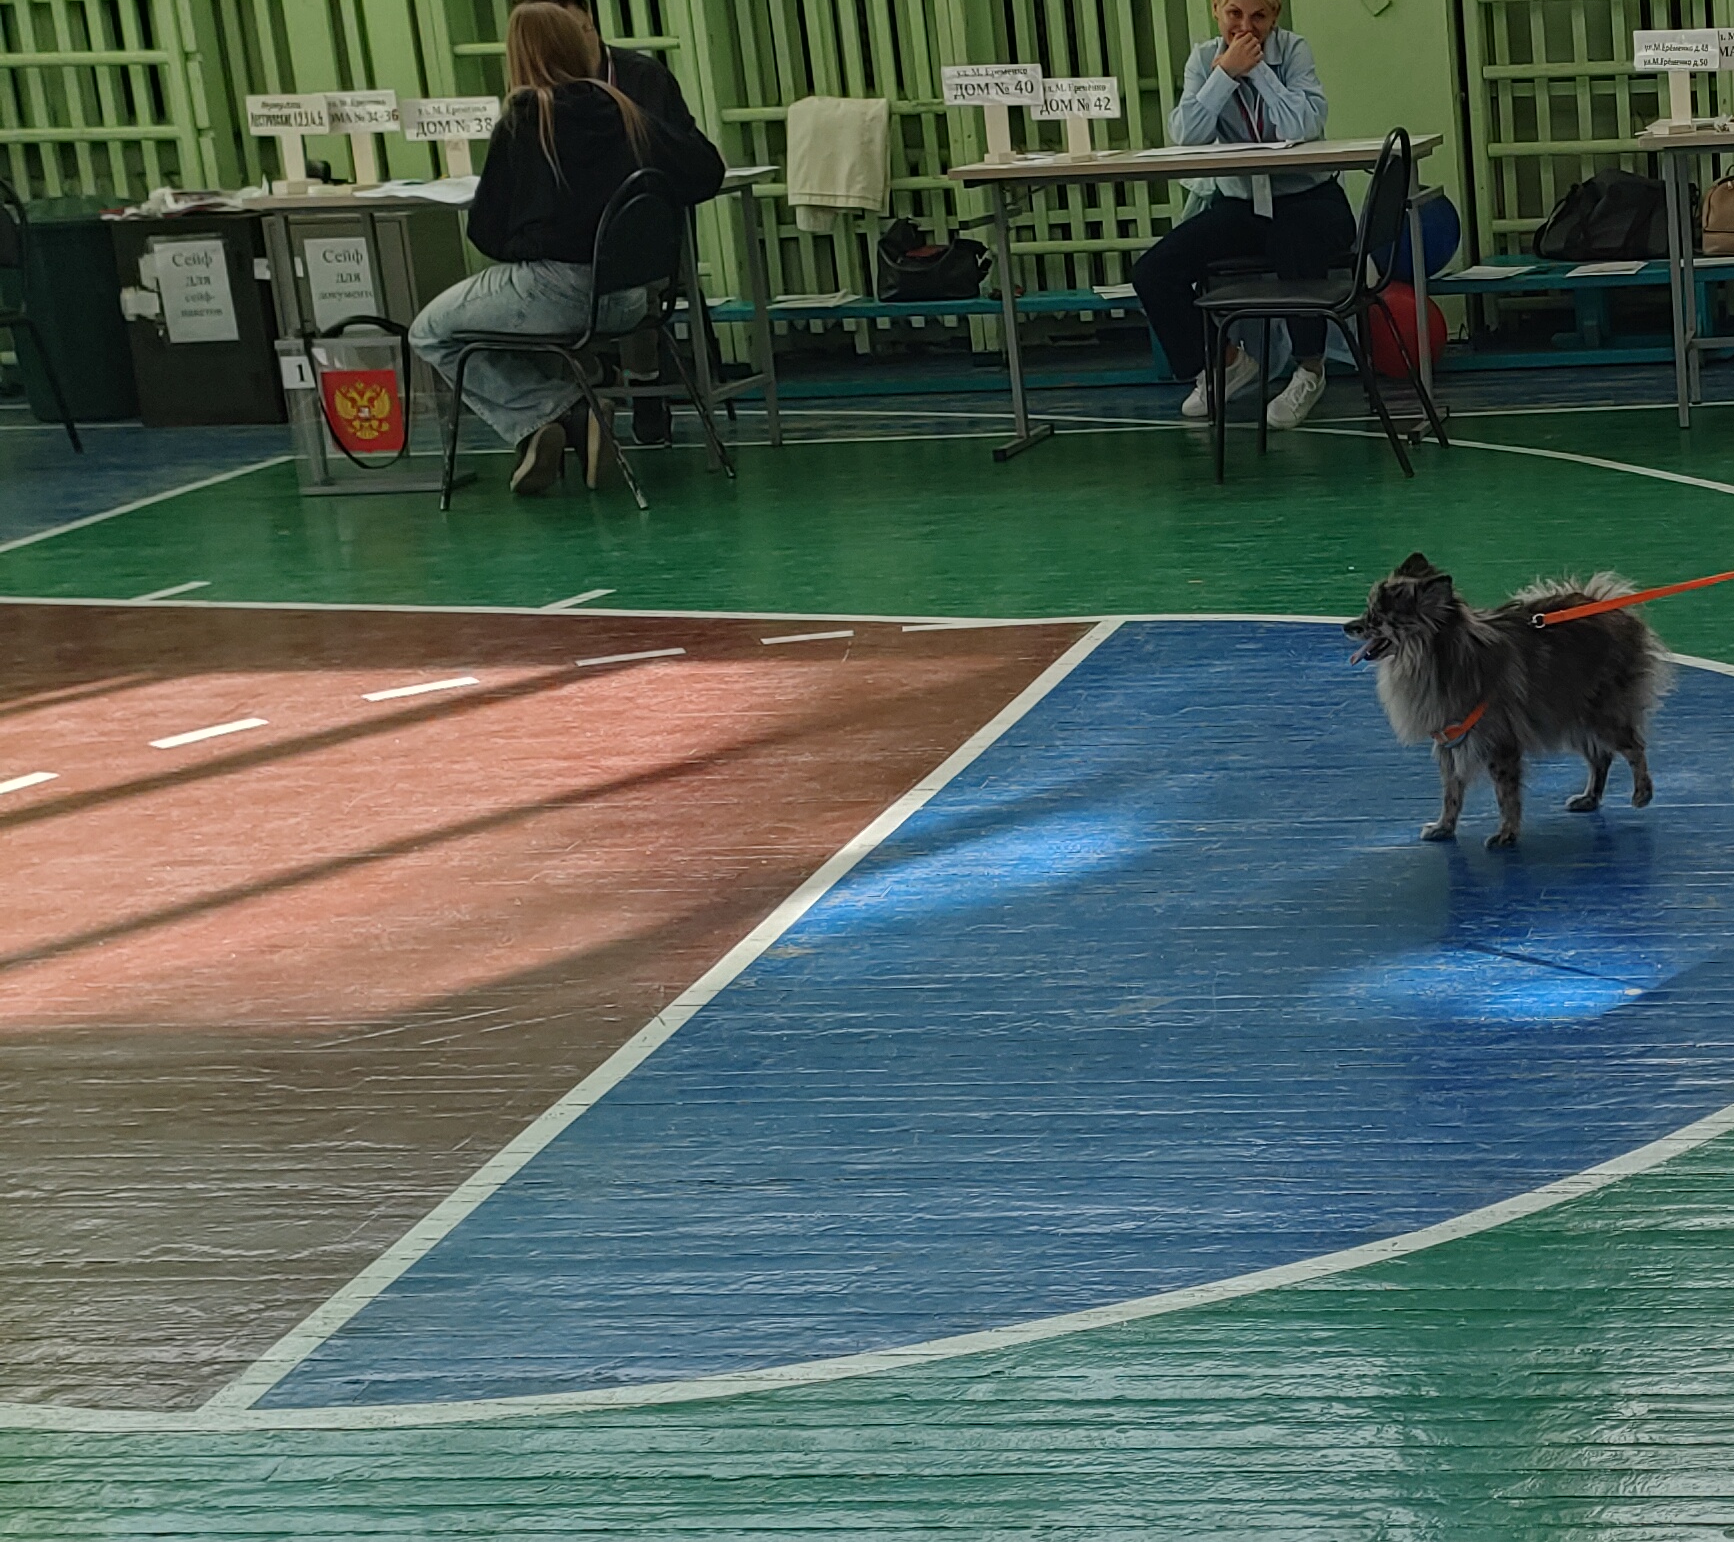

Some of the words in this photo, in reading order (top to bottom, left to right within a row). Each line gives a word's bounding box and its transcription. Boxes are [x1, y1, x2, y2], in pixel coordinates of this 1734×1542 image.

[954, 83, 990, 100] ДОМ
[1014, 80, 1034, 94] 40
[1040, 99, 1073, 116] ДОМ
[1093, 96, 1112, 111] 42
[416, 120, 452, 138] ДОМ
[474, 117, 493, 133] 38
[172, 250, 213, 269] Сейф
[322, 248, 364, 266] Сейф
[185, 276, 211, 288] для
[336, 272, 361, 283] для
[296, 364, 306, 383] 1
